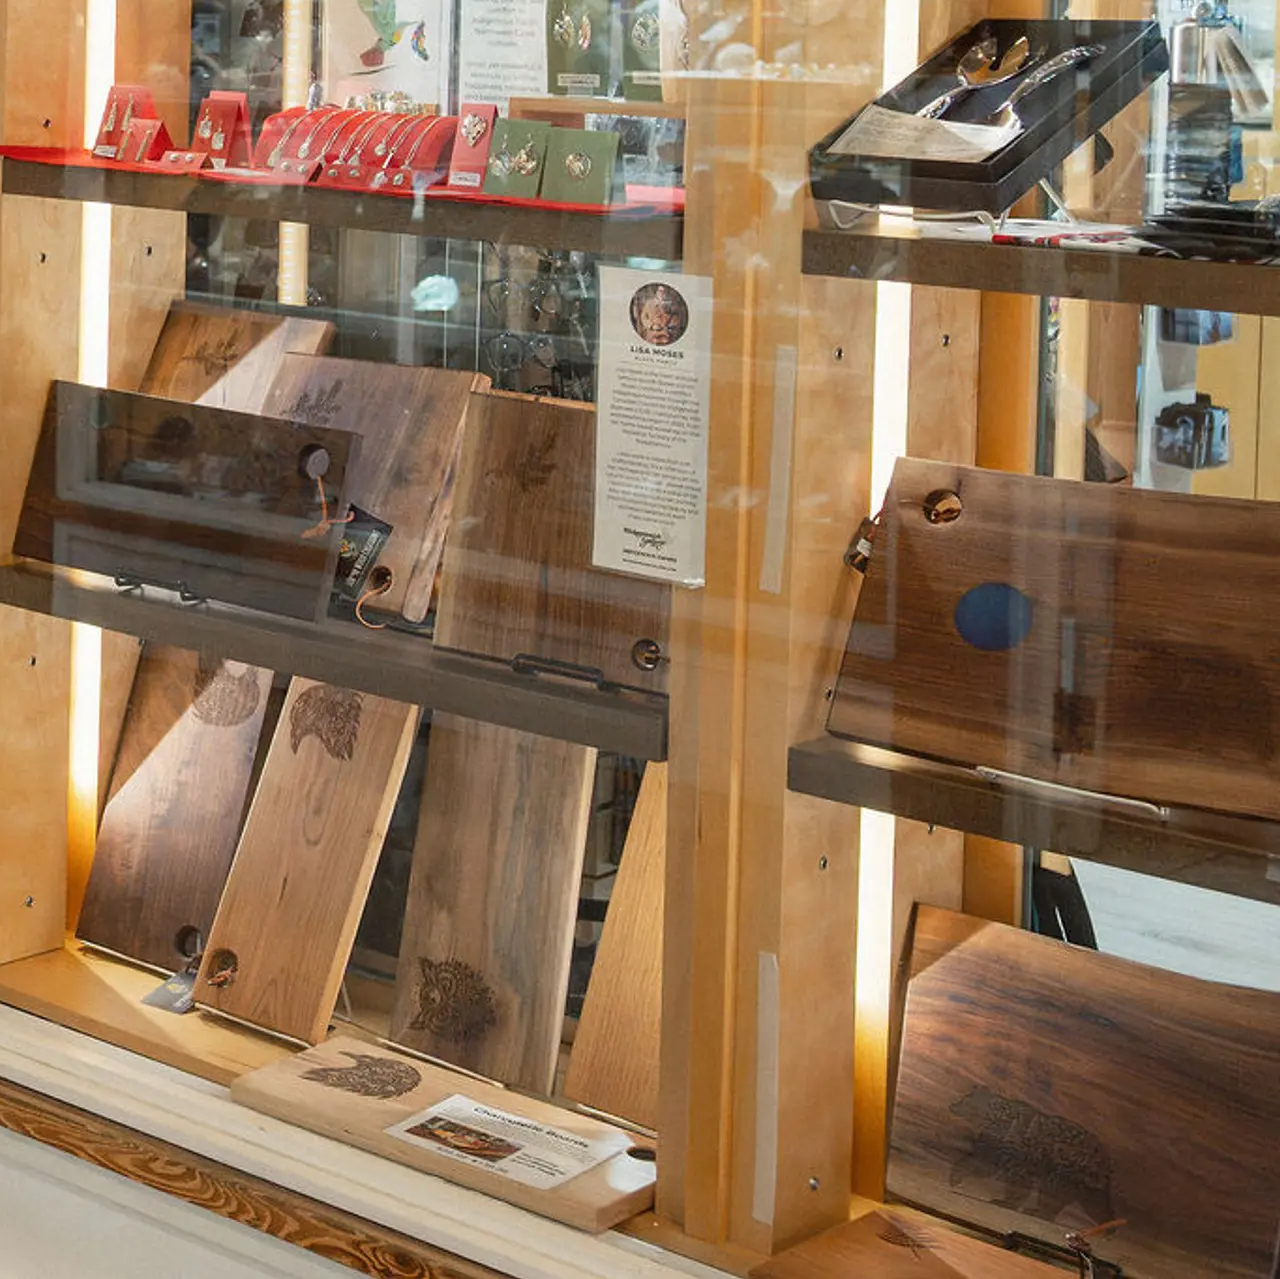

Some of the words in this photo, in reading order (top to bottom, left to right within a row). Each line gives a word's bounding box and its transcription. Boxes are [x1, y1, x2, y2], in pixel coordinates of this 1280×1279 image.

[630, 345, 650, 356] LISA
[653, 348, 684, 360] MOSES
[545, 1128, 590, 1150] Boards
